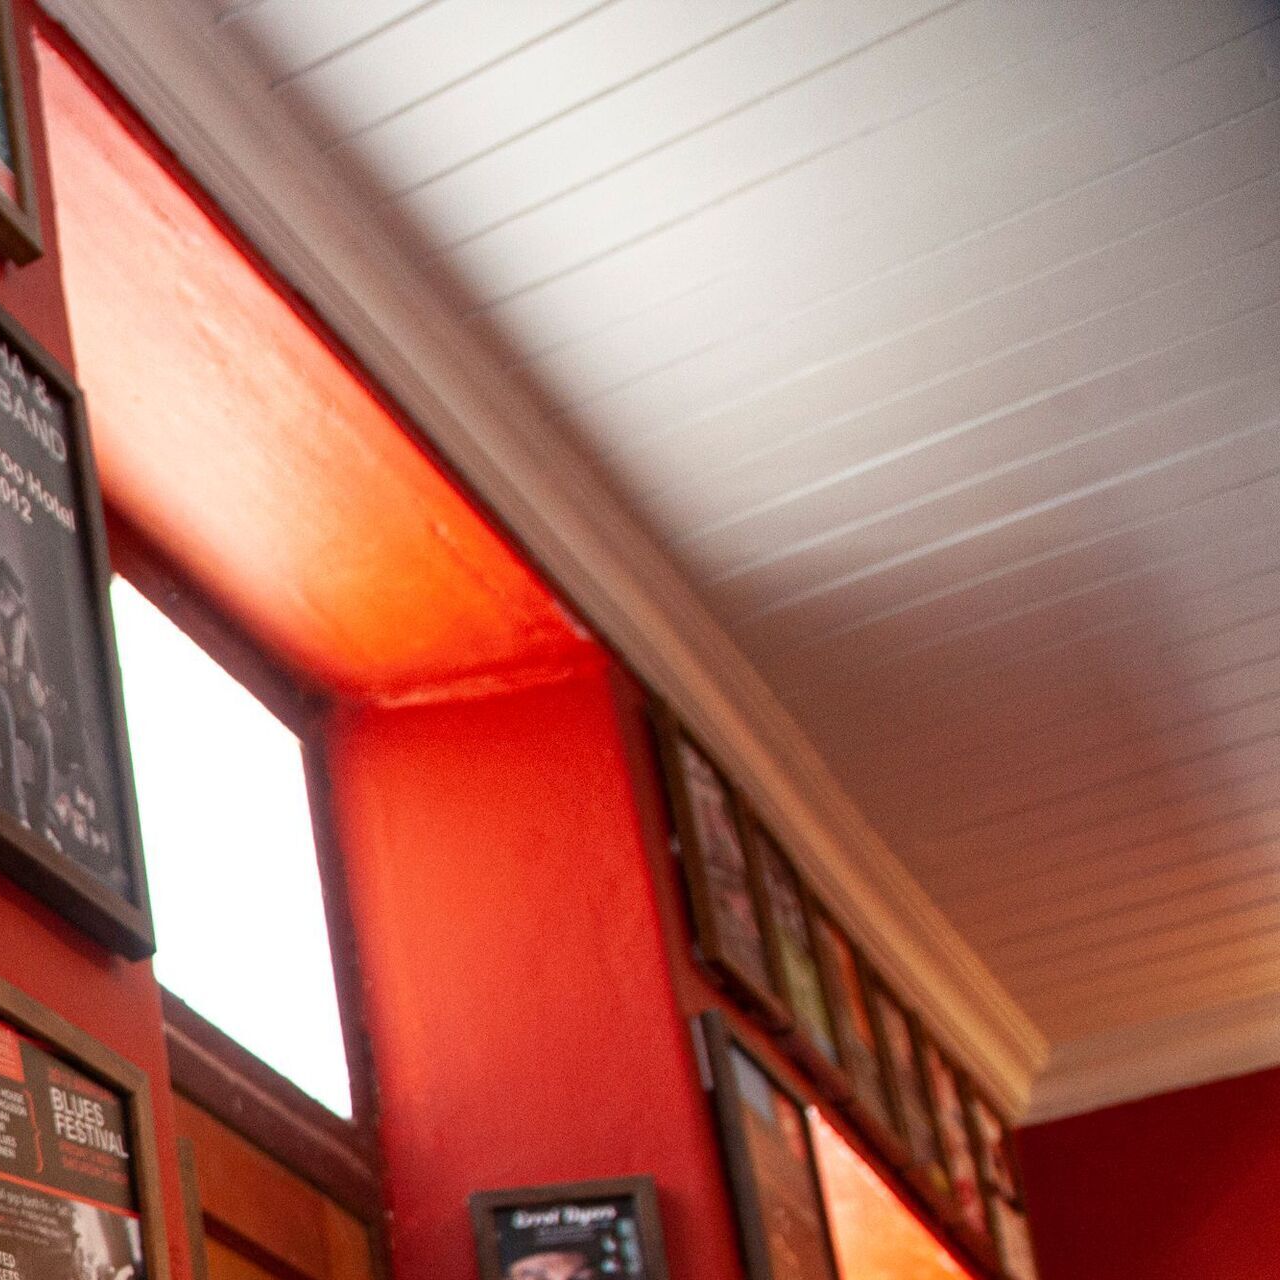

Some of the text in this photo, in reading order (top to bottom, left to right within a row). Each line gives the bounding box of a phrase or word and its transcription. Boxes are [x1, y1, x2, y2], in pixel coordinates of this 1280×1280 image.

[27, 470, 76, 533] Hotel
[49, 1086, 104, 1128] BLUES
[54, 1112, 129, 1159] FESTIVAL
